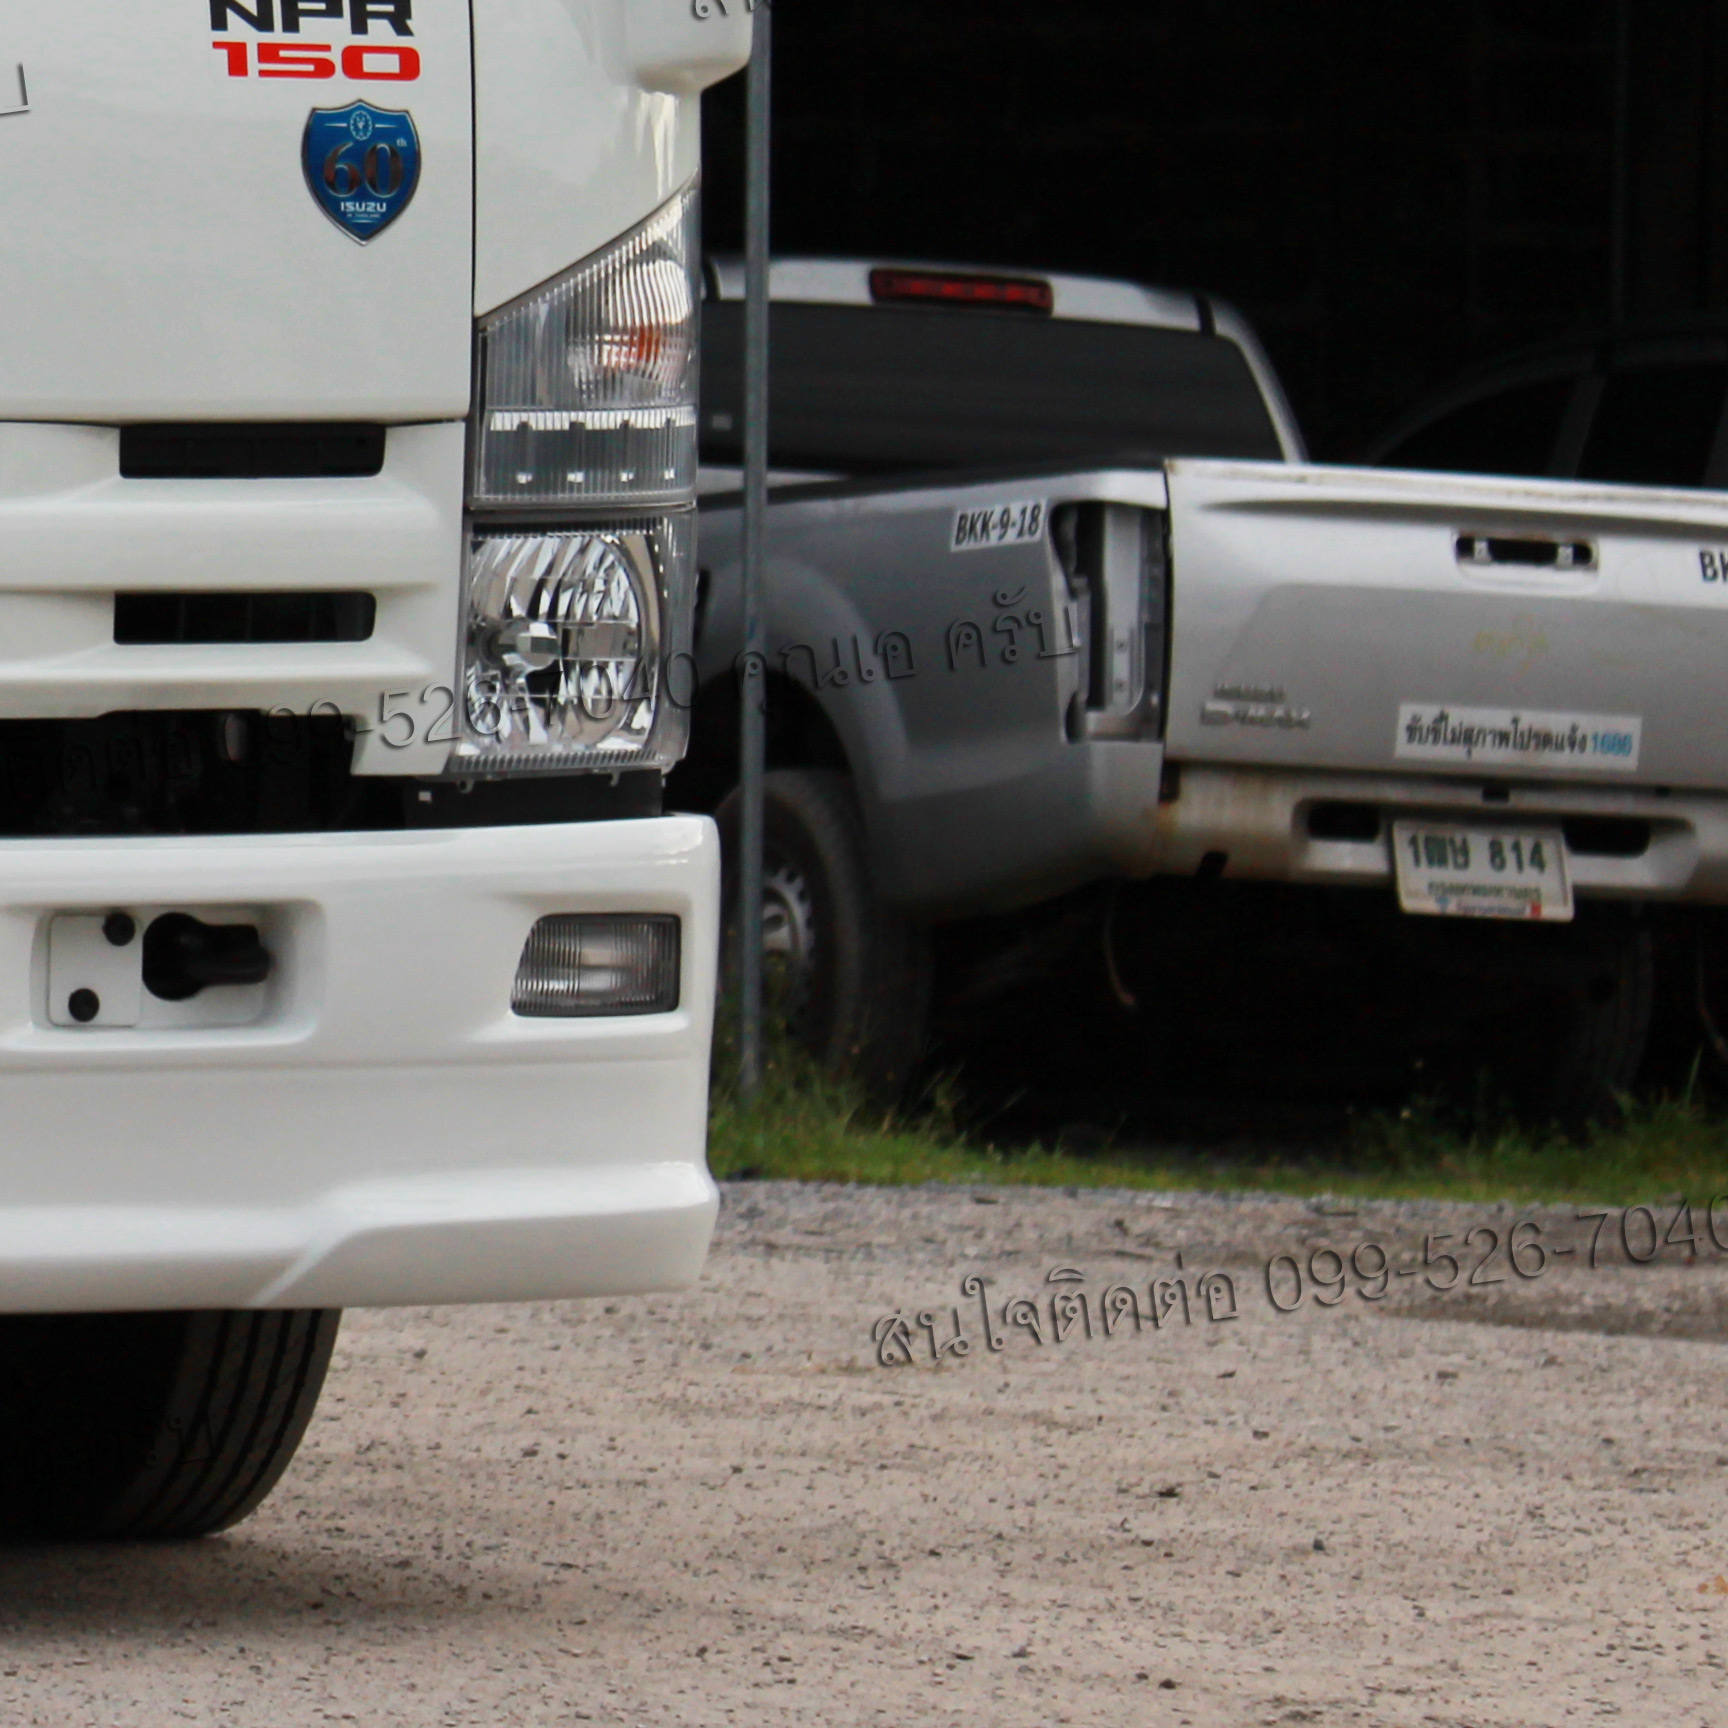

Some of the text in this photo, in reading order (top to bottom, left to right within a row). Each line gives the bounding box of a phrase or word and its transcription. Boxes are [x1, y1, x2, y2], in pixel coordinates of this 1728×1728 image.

[212, 41, 421, 82] 150
[340, 201, 387, 213] ISUZU
[954, 502, 1042, 546] BKK-9-18
[1488, 837, 1547, 875] 814
